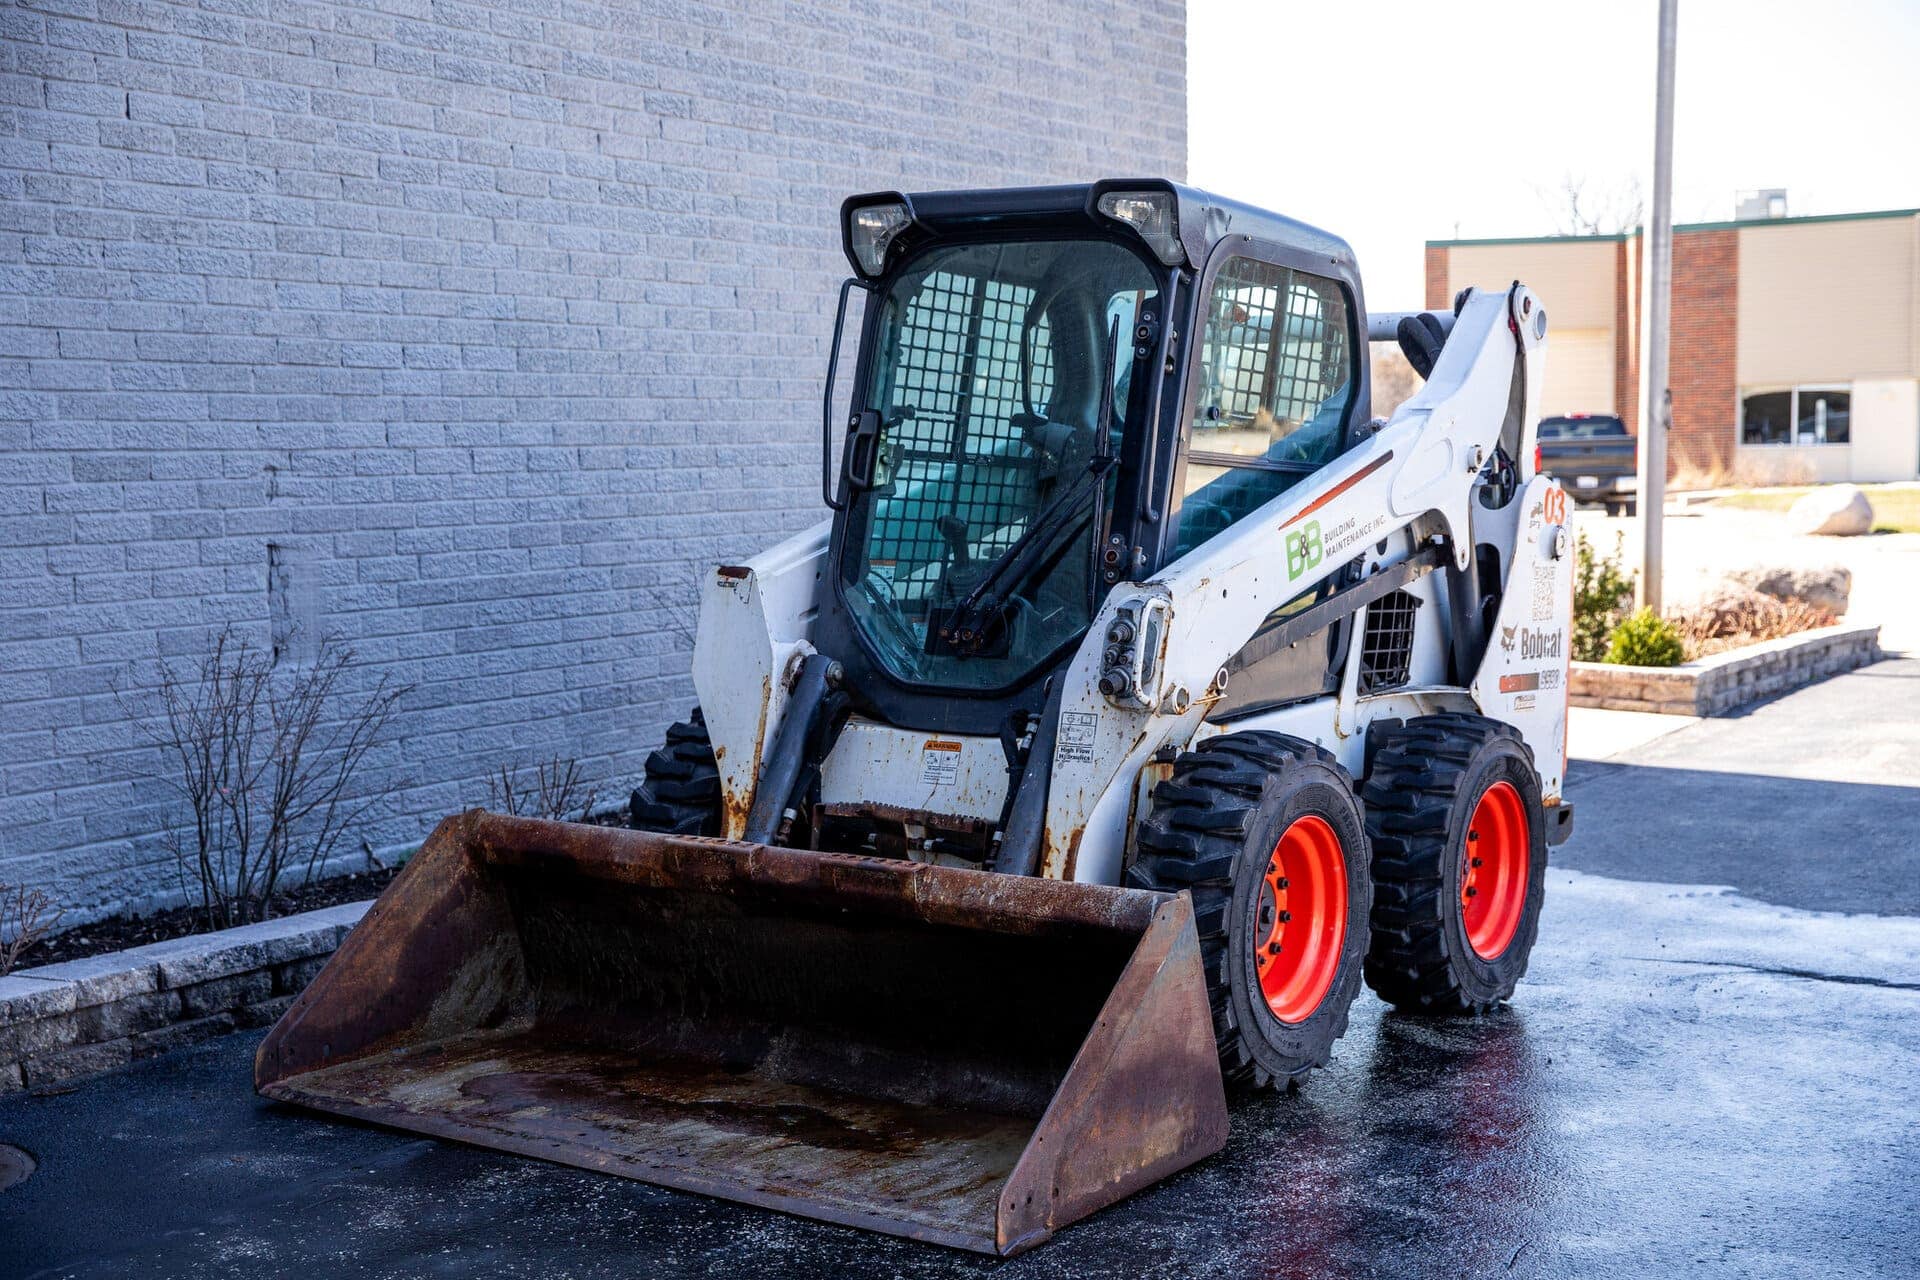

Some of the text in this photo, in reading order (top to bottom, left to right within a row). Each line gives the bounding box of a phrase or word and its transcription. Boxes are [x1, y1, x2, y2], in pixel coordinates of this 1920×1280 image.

[1544, 486, 1566, 525] 03
[1324, 517, 1356, 544] BUILDING
[1325, 525, 1372, 558] MAINTENANCE
[1285, 520, 1323, 582] B&B
[1521, 626, 1562, 660] Bobcat
[933, 743, 961, 751] WARNING
[1058, 753, 1091, 761] Hydraulics
[1060, 746, 1075, 754] High
